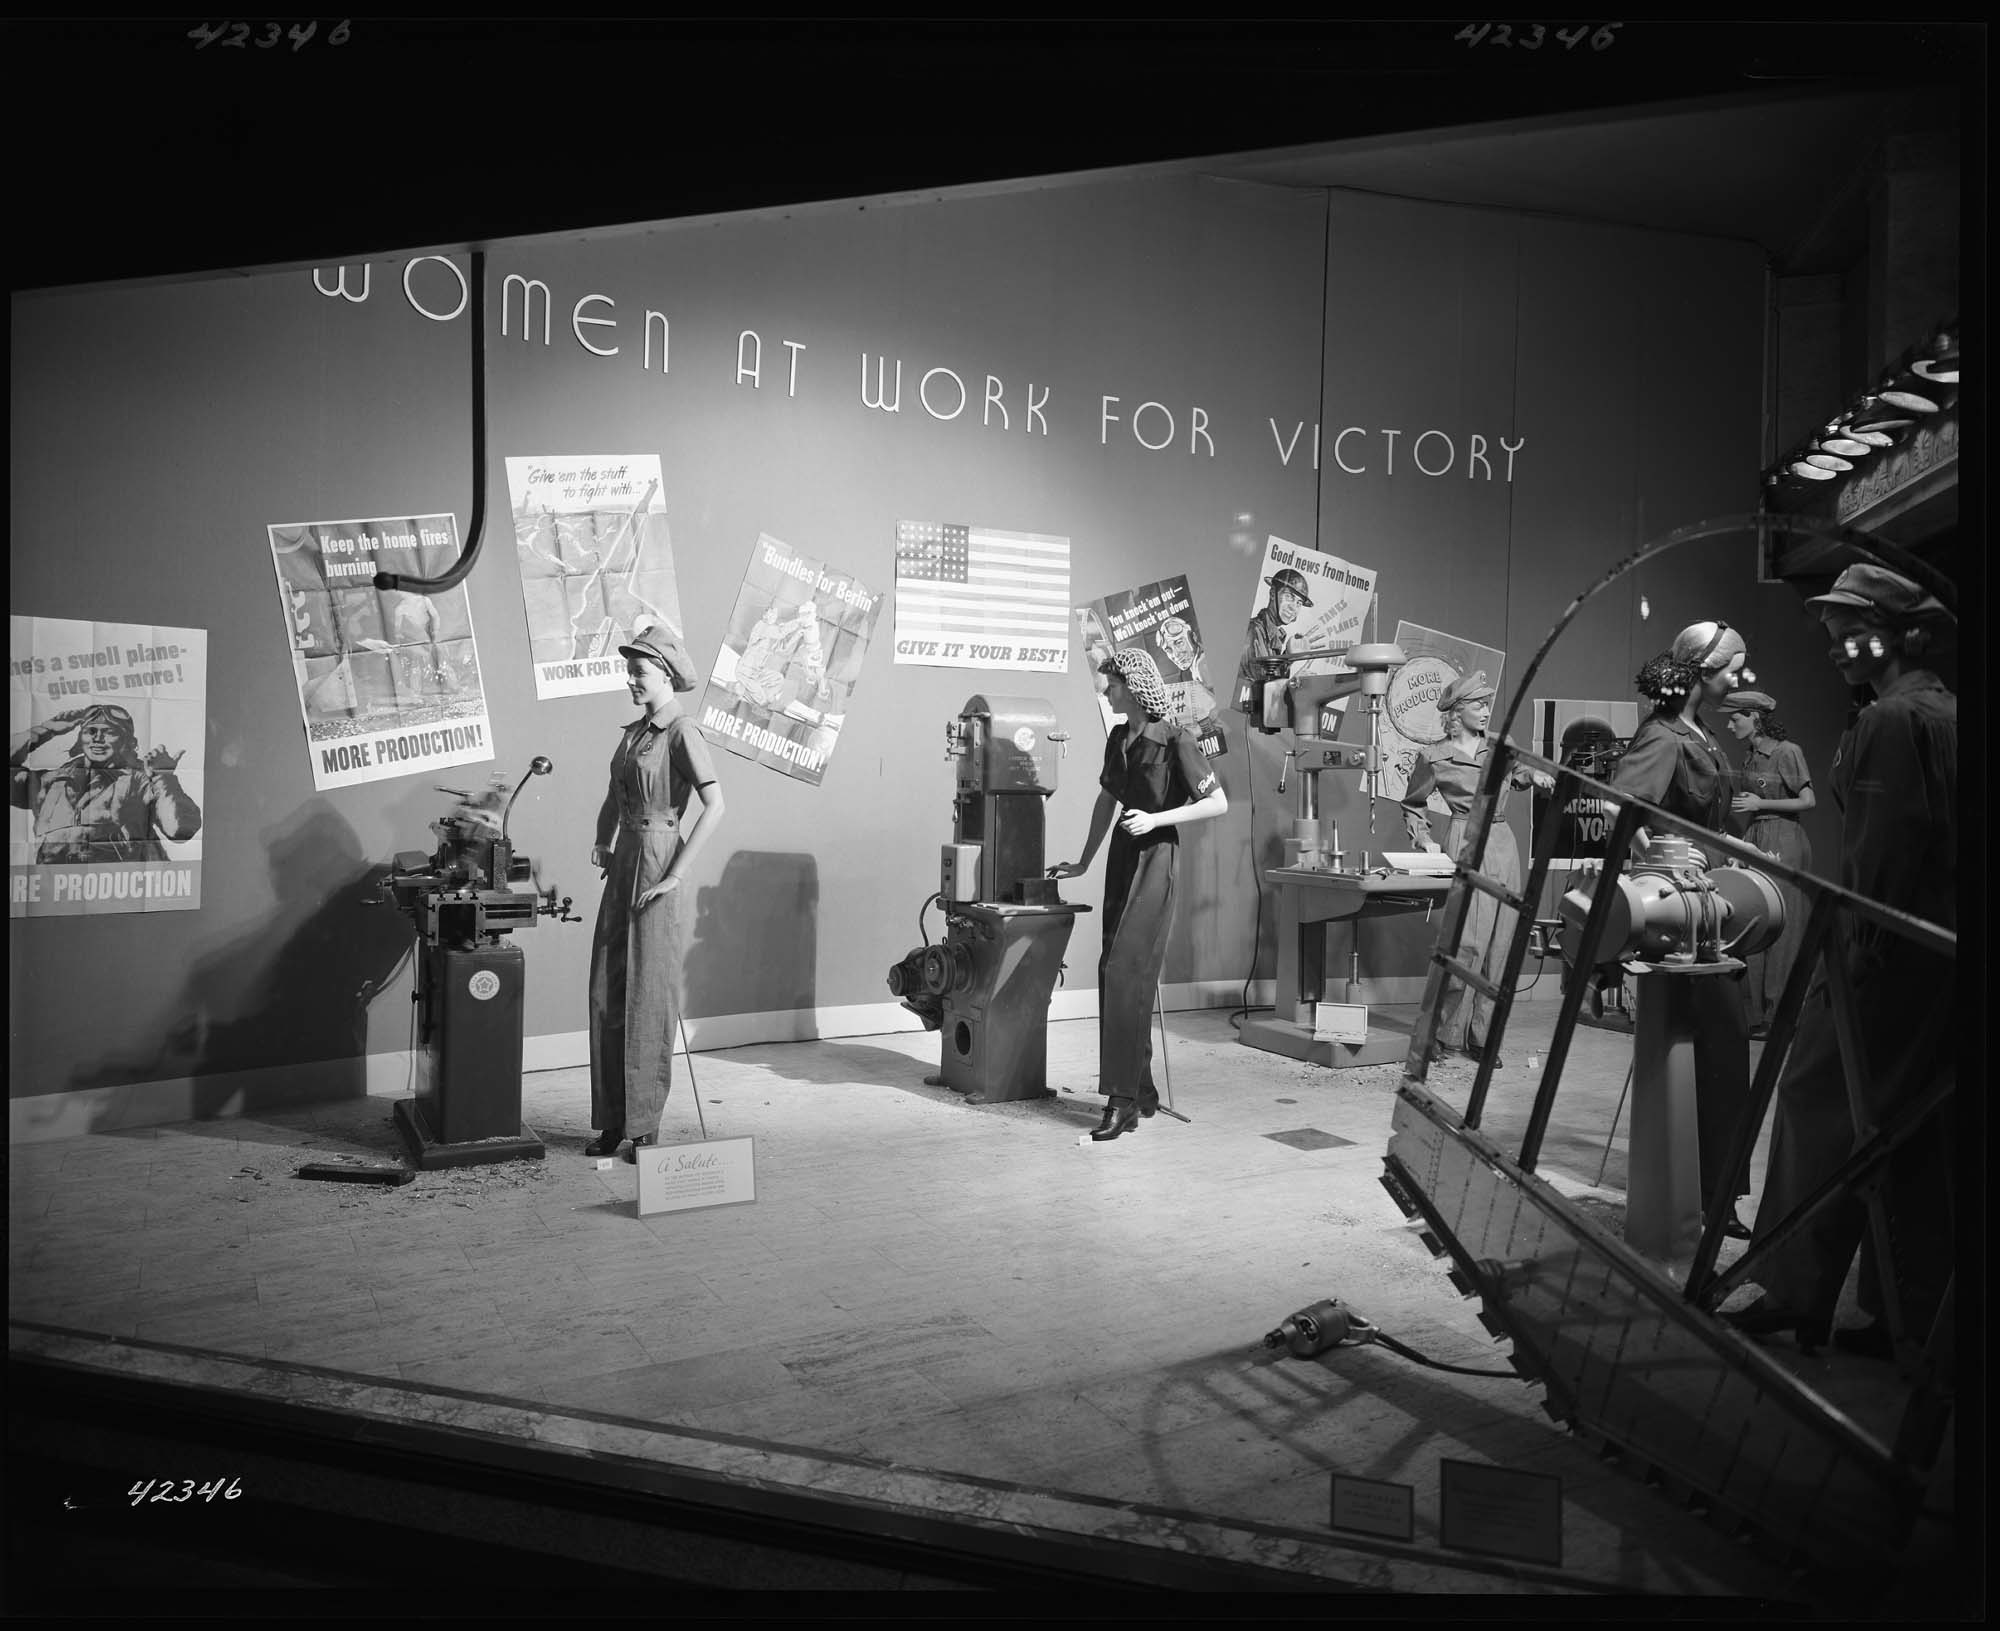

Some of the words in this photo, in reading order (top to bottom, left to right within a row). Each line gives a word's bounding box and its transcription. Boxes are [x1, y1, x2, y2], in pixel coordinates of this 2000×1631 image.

[313, 255, 670, 374] WOMEN
[735, 330, 806, 397] AT
[861, 352, 1050, 435] WORK
[1101, 395, 1215, 457] FOR
[1269, 417, 1525, 482] VICTORY
[580, 466, 597, 481] the
[600, 465, 628, 481] stuff
[563, 486, 575, 499] to
[578, 484, 608, 505] fight
[320, 535, 354, 555] Keep
[357, 533, 380, 551] the
[382, 531, 417, 549] home
[324, 557, 377, 578] burning
[1271, 543, 1295, 566] Good
[1294, 555, 1321, 576] news
[1322, 561, 1345, 583] from
[1344, 570, 1370, 592] home
[815, 570, 836, 594] for
[1108, 615, 1124, 628] You
[1124, 601, 1149, 621] knock
[1134, 615, 1157, 634] knock
[1169, 598, 1190, 615] down
[50, 656, 63, 672] a
[67, 645, 121, 670] swell
[896, 640, 940, 656] GIVE
[942, 642, 964, 658] IT
[969, 644, 1013, 661] YOUR
[1017, 647, 1068, 664] BEST!
[542, 663, 583, 681] WORK
[586, 660, 611, 677] FOR
[1407, 671, 1441, 690] MORE
[48, 677, 91, 700] give
[95, 675, 120, 692] us
[321, 742, 372, 774] MORE
[375, 724, 484, 765] PRODUCTION!
[702, 705, 744, 739] MORE
[741, 721, 826, 773] PRODUCTION!
[1562, 798, 1604, 814] ATCHI
[11, 873, 41, 903] RE
[53, 869, 192, 903] PRODUCTION
